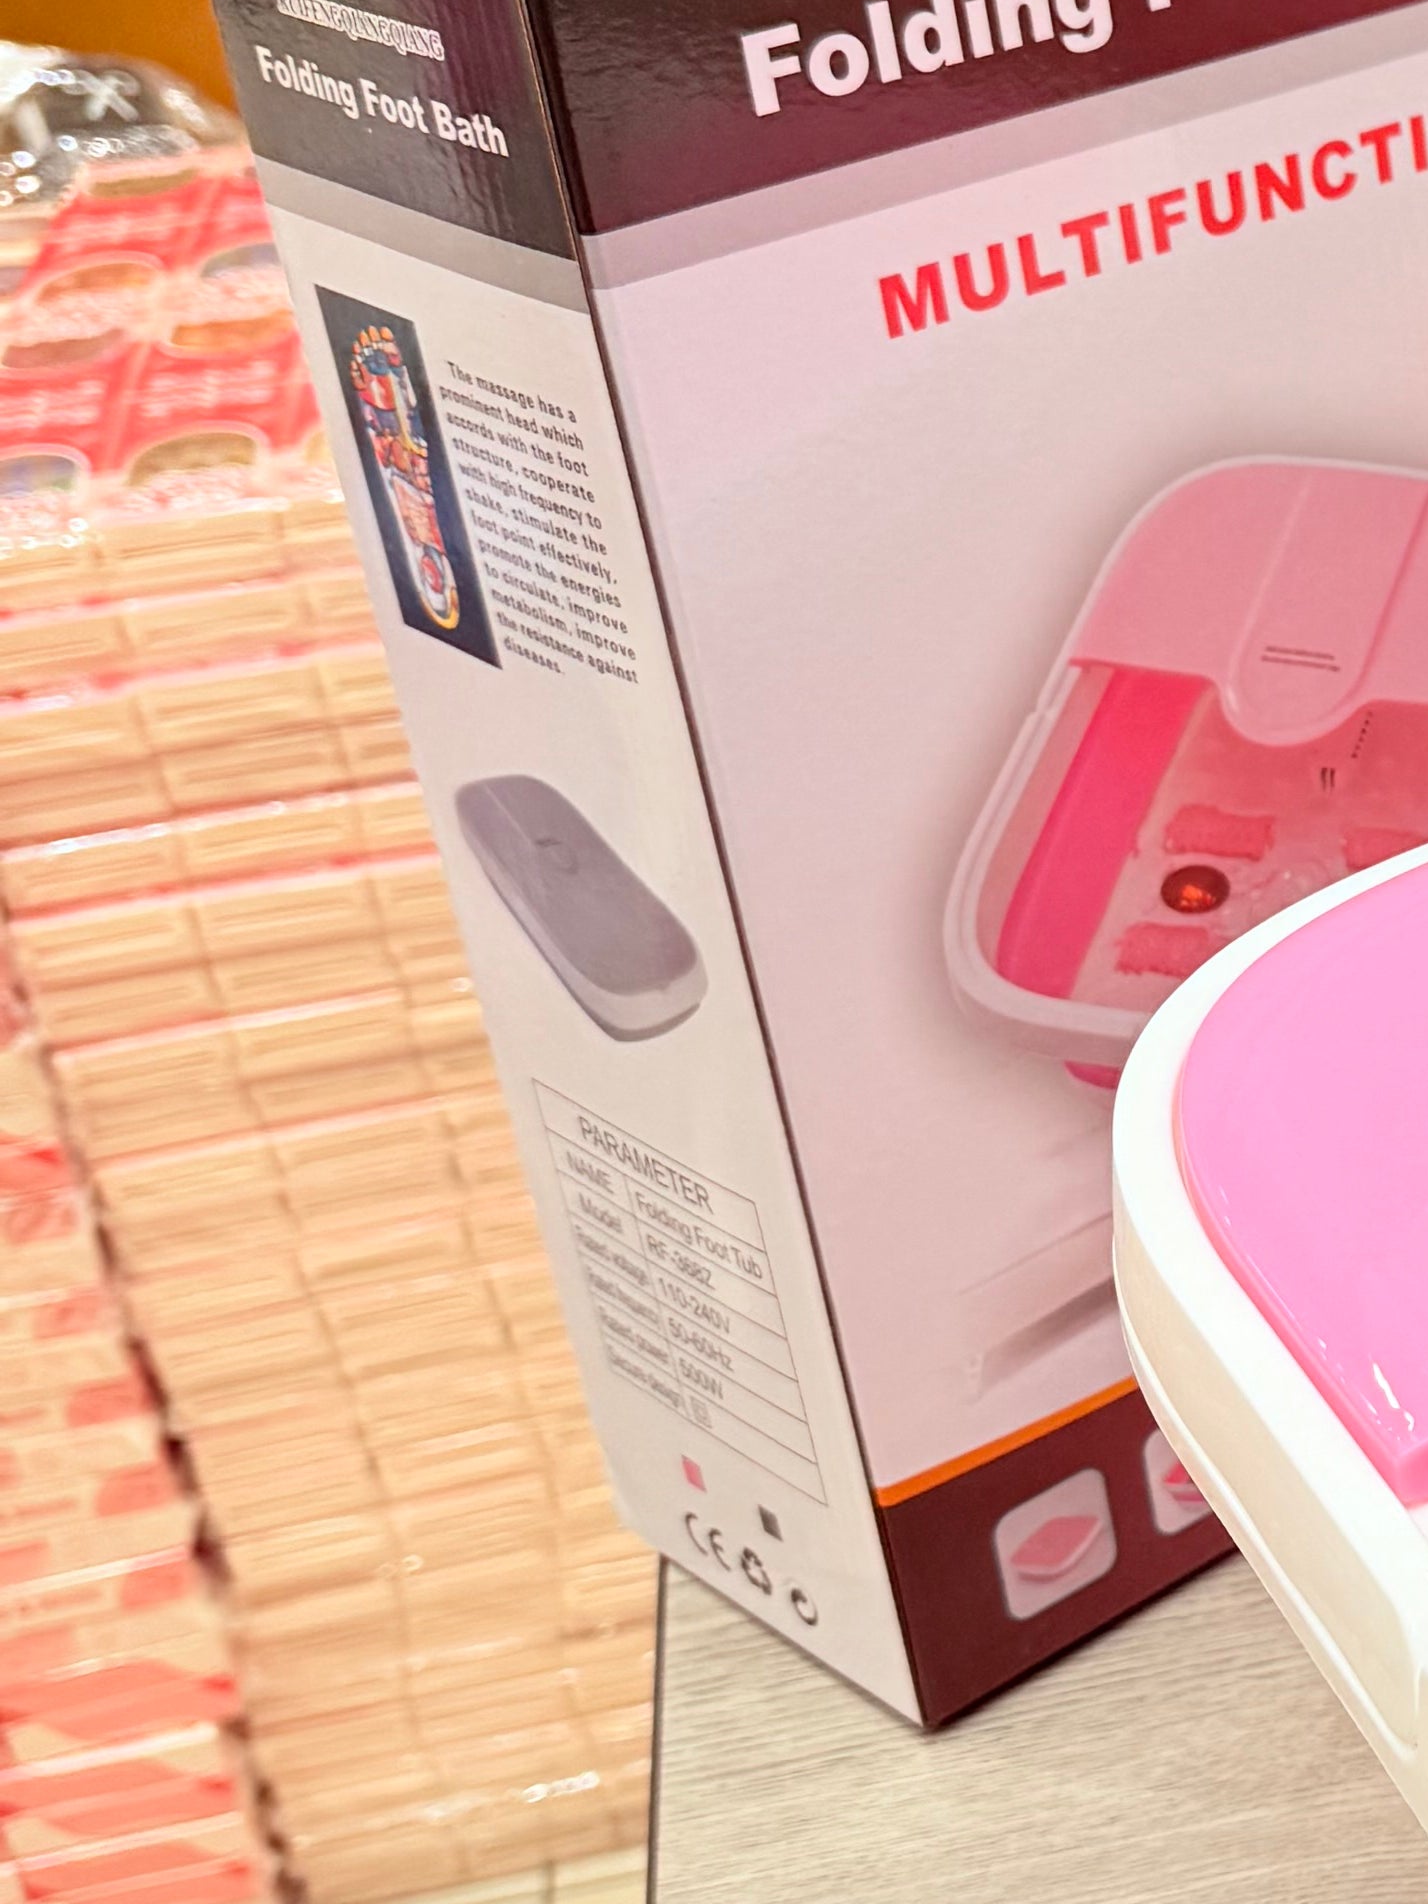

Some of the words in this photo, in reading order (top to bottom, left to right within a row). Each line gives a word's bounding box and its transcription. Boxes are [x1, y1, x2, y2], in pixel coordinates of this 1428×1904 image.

[255, 44, 360, 120] Folding
[359, 77, 430, 134] Foot
[430, 99, 510, 158] Bath
[447, 360, 473, 385] The
[476, 376, 534, 409] massage
[538, 395, 564, 419] has
[568, 410, 577, 423] a
[446, 412, 494, 441] accords
[497, 431, 528, 454] with
[531, 444, 554, 464] the
[557, 452, 589, 477] foot
[506, 408, 538, 434] head
[541, 425, 584, 450] which
[458, 462, 487, 484] with
[489, 472, 516, 497] high
[518, 484, 583, 525] frequency
[586, 512, 602, 530] to
[522, 466, 595, 503] cooperate
[471, 509, 498, 535] foot
[501, 526, 535, 551] point
[512, 508, 578, 545] stimulate
[581, 534, 607, 556] the
[478, 538, 532, 572] promote
[535, 563, 557, 583] the
[561, 575, 622, 608] energies
[484, 562, 499, 579] to
[568, 596, 628, 634] improve
[497, 611, 518, 631] the
[588, 656, 639, 684] against
[576, 622, 636, 661] improve
[577, 1114, 714, 1215] PARAMETER
[729, 1245, 763, 1280] Tub
